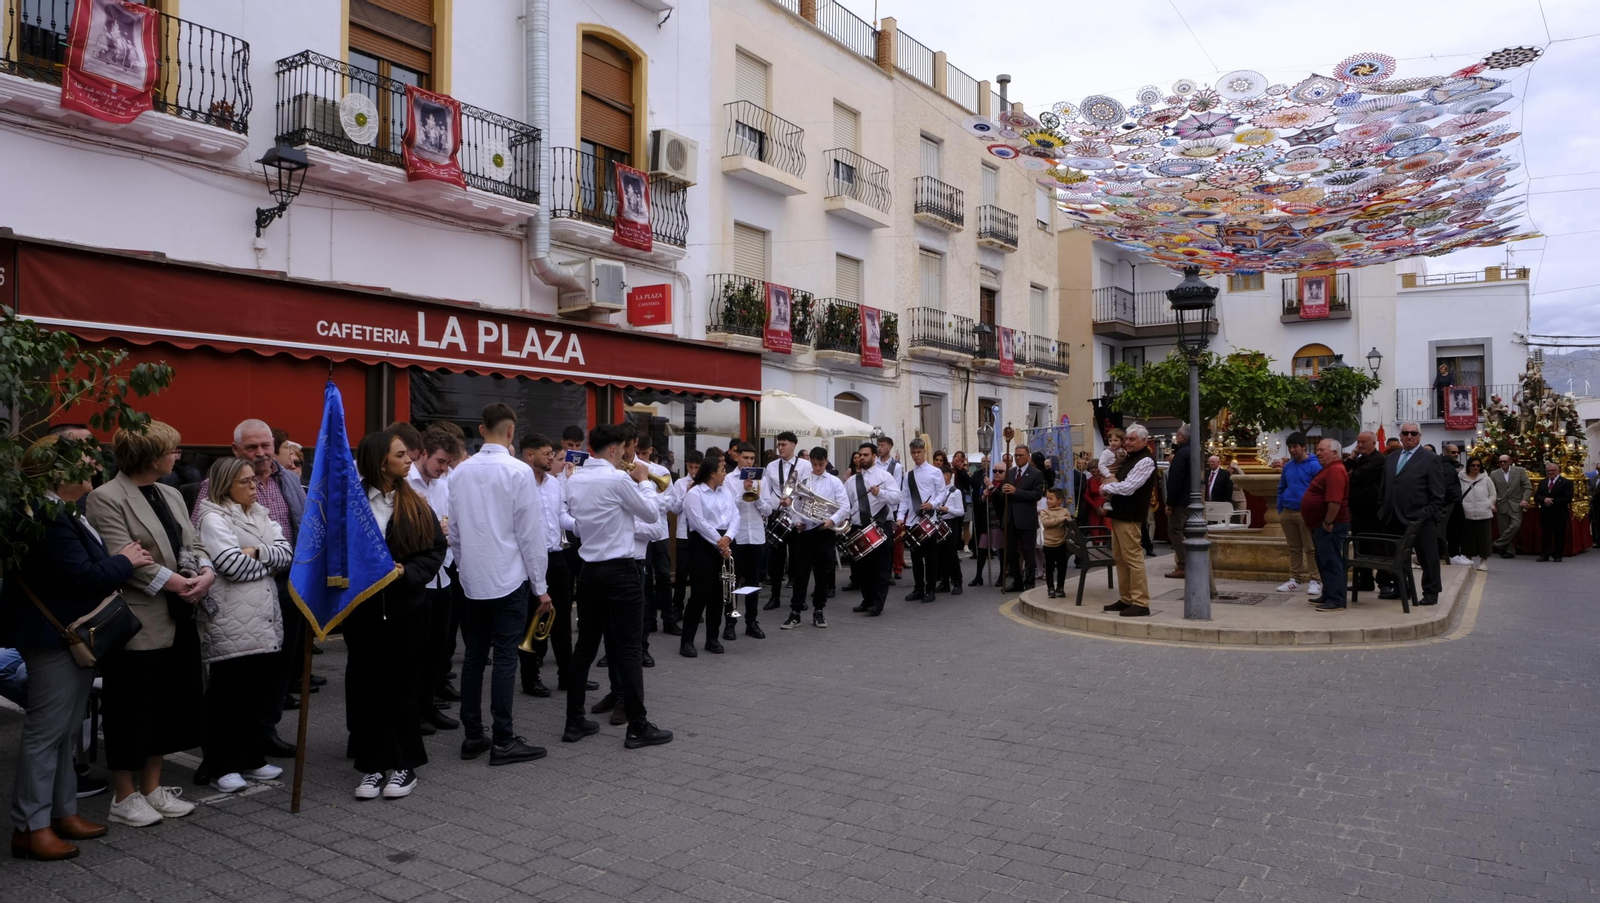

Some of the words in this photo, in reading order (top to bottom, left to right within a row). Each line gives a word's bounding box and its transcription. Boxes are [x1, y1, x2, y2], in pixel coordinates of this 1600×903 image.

[316, 320, 410, 345] CAFETERIA
[417, 311, 467, 352] LA
[477, 319, 586, 365] PLAZA
[349, 500, 388, 559] CORNETAS
